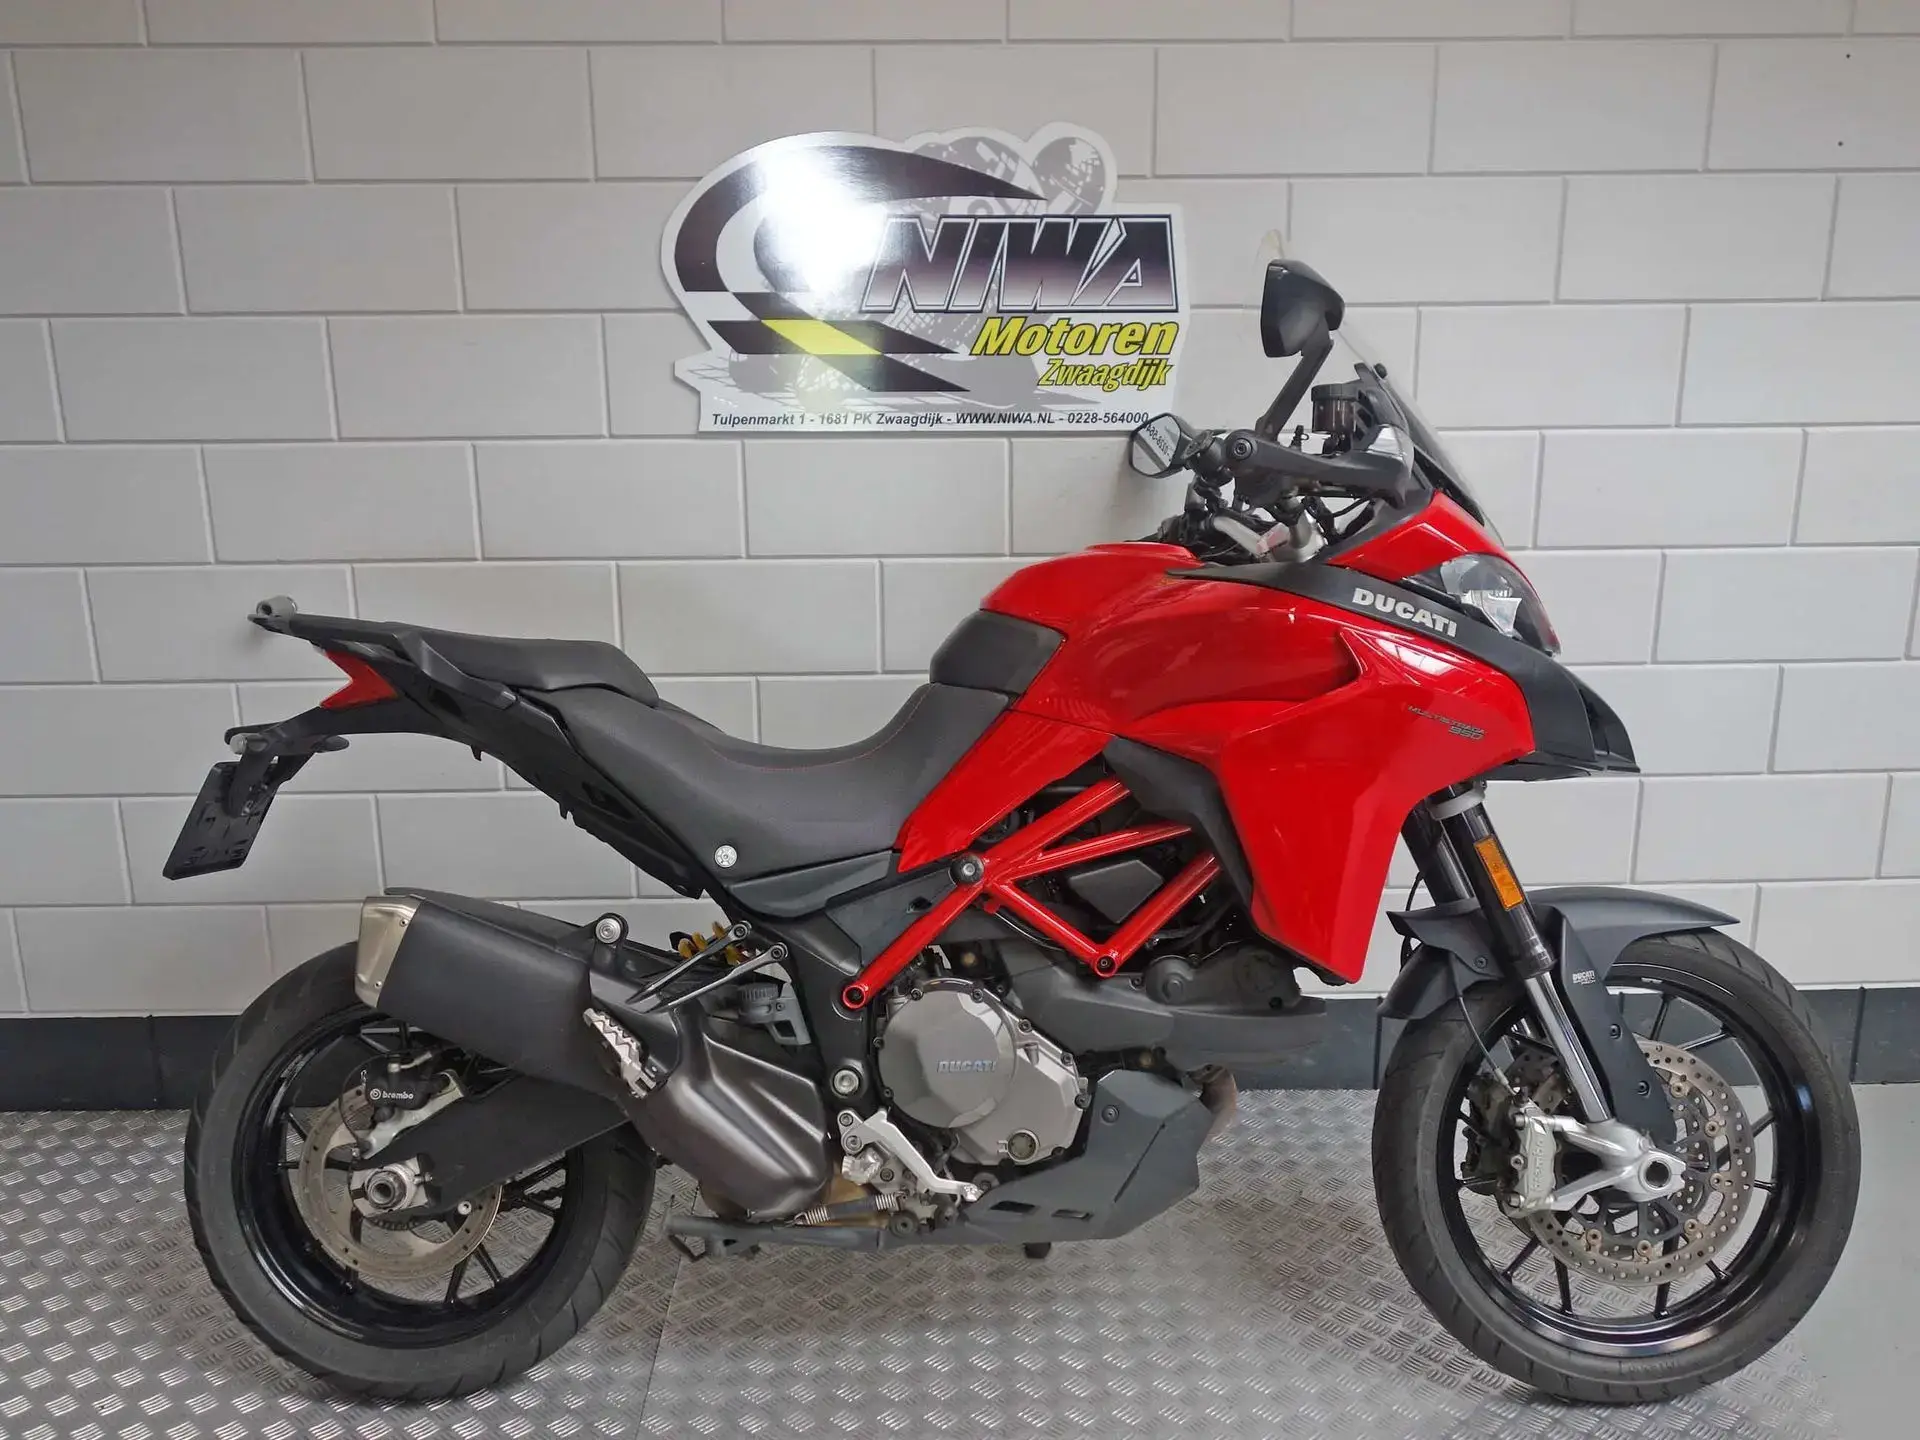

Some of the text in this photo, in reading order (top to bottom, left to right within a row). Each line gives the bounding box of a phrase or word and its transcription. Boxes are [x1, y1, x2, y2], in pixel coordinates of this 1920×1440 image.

[860, 214, 1179, 313] NIWA
[970, 317, 1178, 357] Motoren
[1038, 358, 1172, 391] Zwaagdijk
[712, 413, 795, 428] Tulpenmarkt
[799, 413, 805, 425] 1
[819, 413, 849, 425] 1681
[853, 413, 873, 425] PK
[876, 412, 943, 427] Zwaagdijk
[956, 412, 1055, 424] WWW.NIWA.NL
[1067, 412, 1149, 424] 0228-564000
[1352, 588, 1457, 637] DUCATI
[937, 1059, 997, 1073] DUCATI
[382, 1090, 413, 1100] brembo
